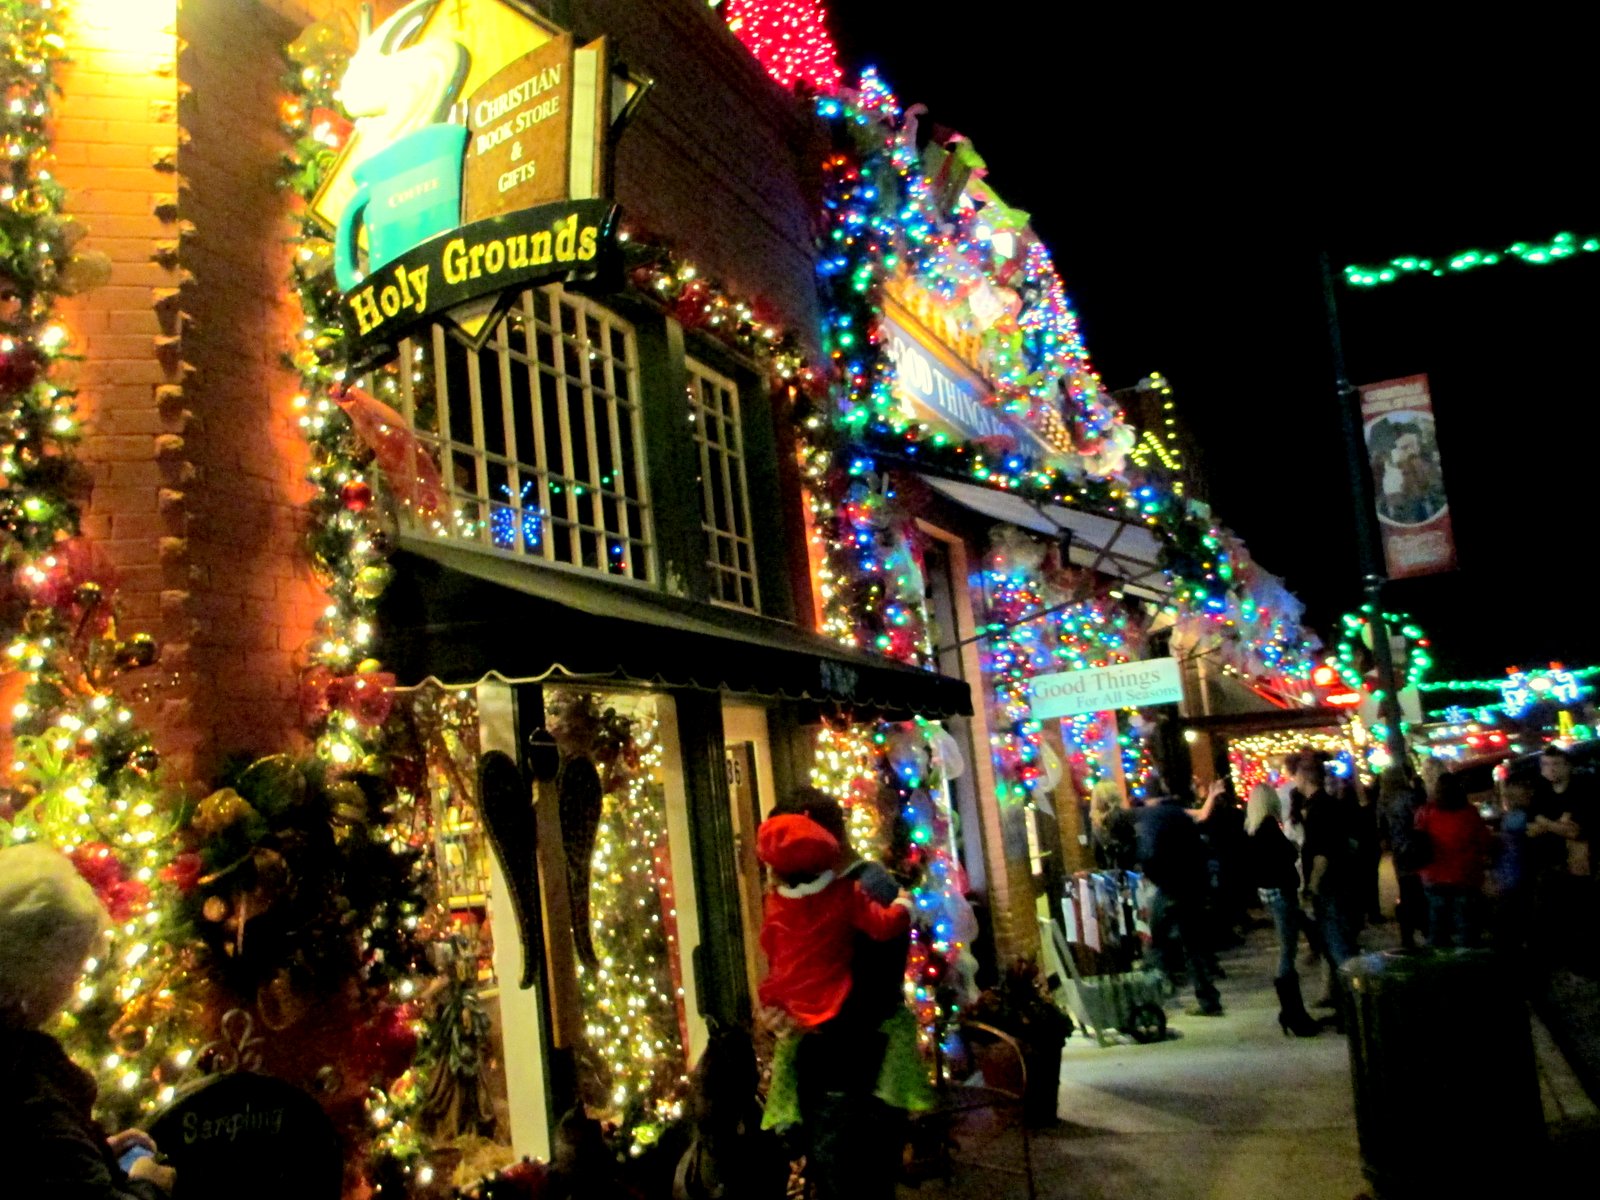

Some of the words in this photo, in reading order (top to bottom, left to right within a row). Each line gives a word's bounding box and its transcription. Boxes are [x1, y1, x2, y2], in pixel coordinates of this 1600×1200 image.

[475, 64, 562, 128] CHRISTIAN
[476, 120, 514, 155] BOOK
[515, 96, 560, 134] STORE
[510, 140, 523, 162] &
[497, 160, 536, 193] GIFTS
[350, 264, 431, 337] Holy
[442, 213, 598, 286] Grounds
[1033, 675, 1086, 700] Good
[1091, 669, 1162, 692] Things
[1076, 695, 1095, 709] For
[1103, 690, 1123, 705] All
[1127, 686, 1179, 702] Seasons
